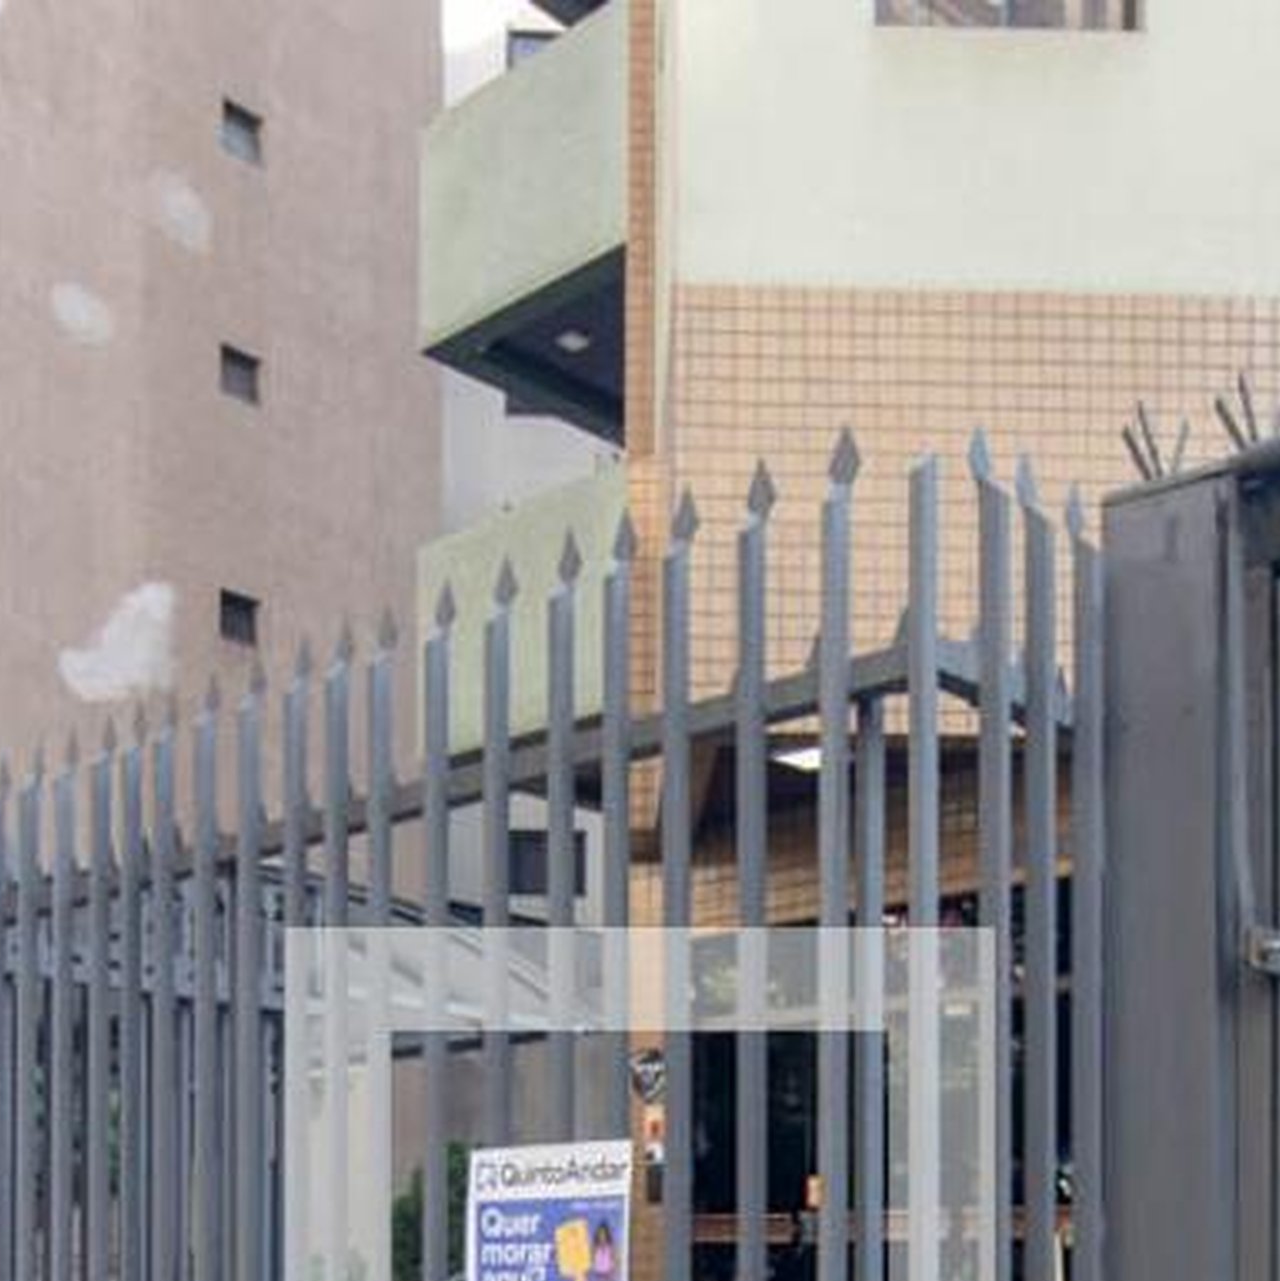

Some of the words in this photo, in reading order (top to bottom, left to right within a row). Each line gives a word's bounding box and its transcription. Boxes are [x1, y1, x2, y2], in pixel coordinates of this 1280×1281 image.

[501, 1154, 628, 1187] QuintoAndar
[481, 1208, 541, 1238] Quer
[481, 1243, 552, 1265] morar
